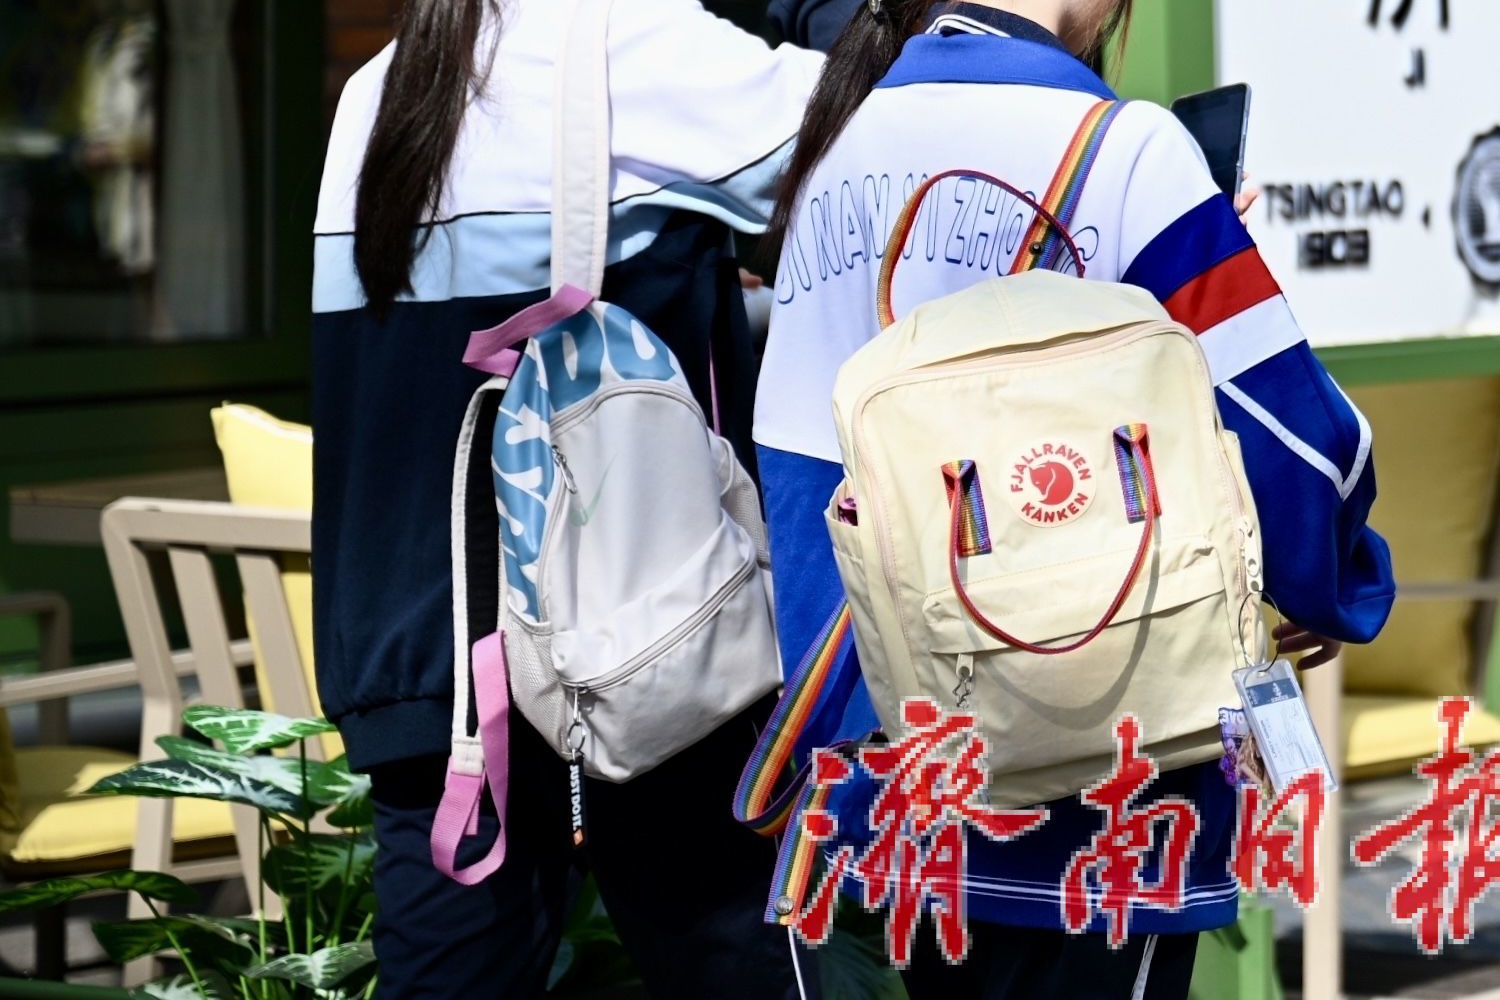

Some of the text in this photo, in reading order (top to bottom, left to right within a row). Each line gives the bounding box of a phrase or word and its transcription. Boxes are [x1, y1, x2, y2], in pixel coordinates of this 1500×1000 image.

[1404, 50, 1427, 88] JI
[1263, 180, 1404, 224] TSINGTAO
[569, 764, 581, 795] JUST
[571, 794, 582, 815] DO
